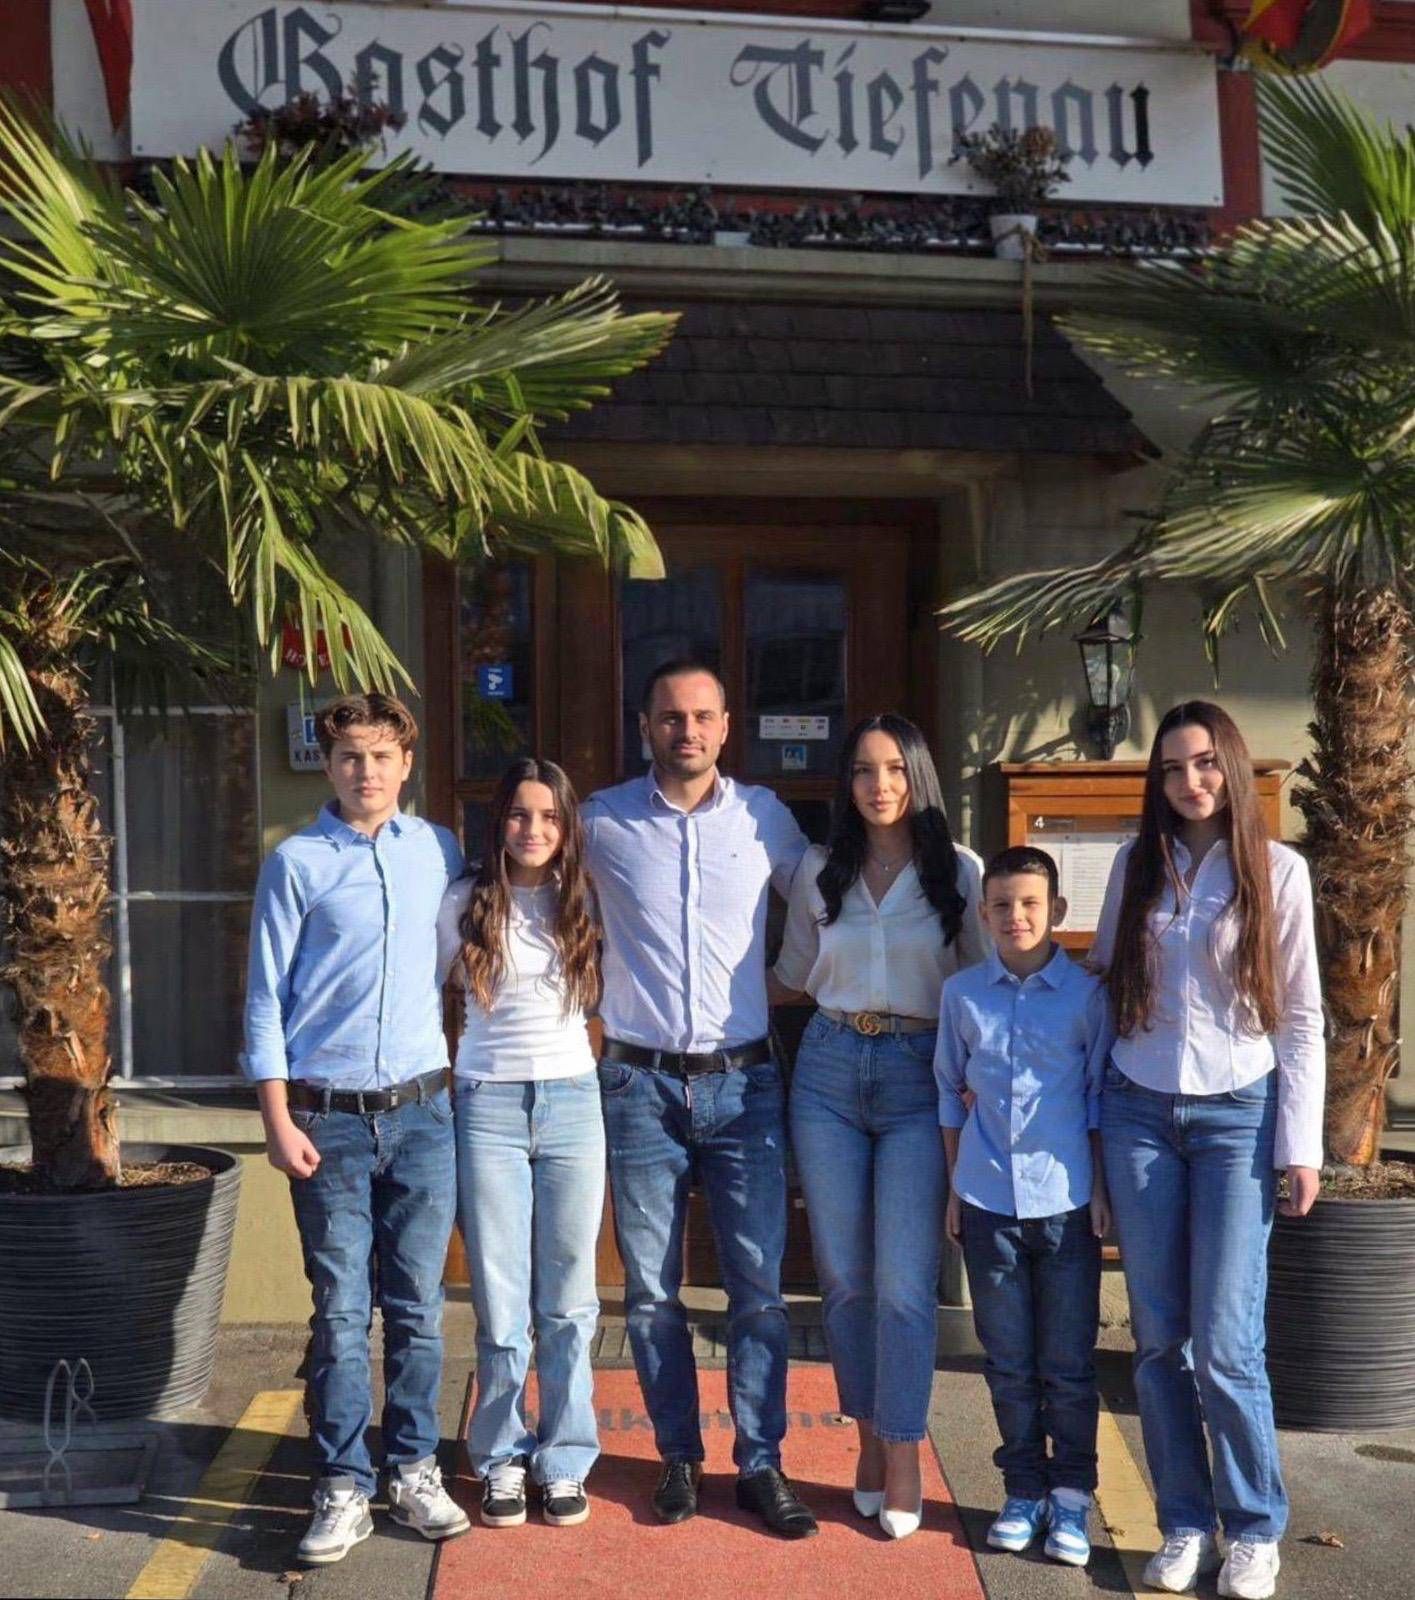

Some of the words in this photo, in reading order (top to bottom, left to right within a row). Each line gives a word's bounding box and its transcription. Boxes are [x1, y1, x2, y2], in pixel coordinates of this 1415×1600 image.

[218, 7, 671, 168] Gasthof
[730, 38, 1155, 180] Tiefenau
[294, 750, 321, 762] KAS
